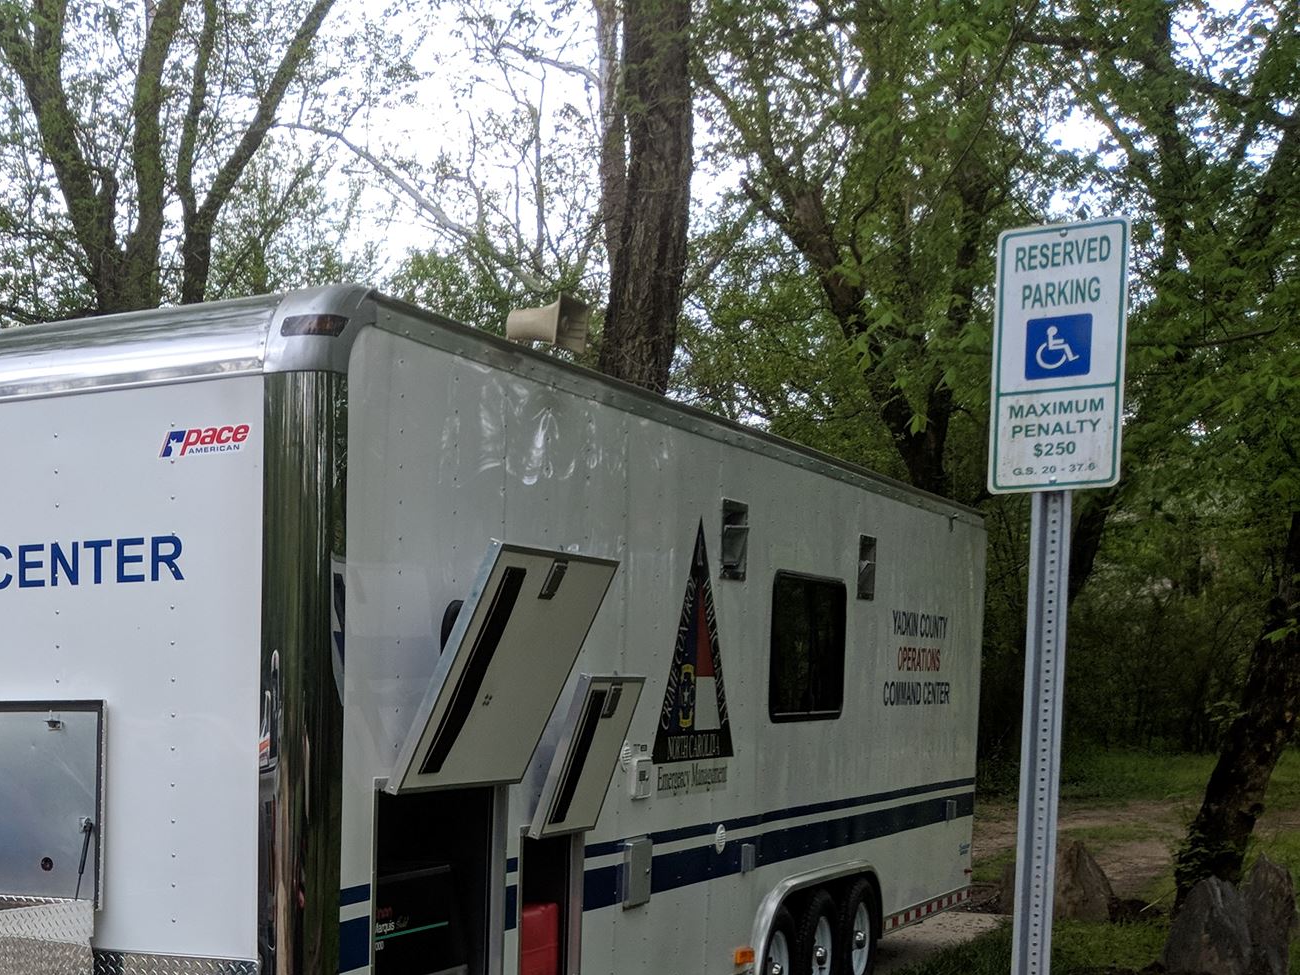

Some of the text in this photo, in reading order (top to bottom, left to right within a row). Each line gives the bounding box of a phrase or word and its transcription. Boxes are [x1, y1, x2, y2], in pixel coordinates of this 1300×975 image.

[1015, 235, 1111, 272] RESERVED
[1022, 276, 1101, 310] PARKING
[1009, 397, 1105, 419] MAXIMUM
[180, 424, 250, 456] pace
[1011, 418, 1102, 439] PENALTY
[188, 444, 240, 455] AMERICAN
[1033, 441, 1076, 458] $250
[1012, 466, 1037, 476] G.S.
[1042, 465, 1057, 474] 20
[893, 610, 948, 639] YADKIN COUNTY
[897, 646, 941, 672] OPERATIONS
[883, 681, 950, 707] COMMAND CENTER
[667, 733, 721, 761] NORTH CAROLINA
[657, 762, 728, 796] Emergency Management
